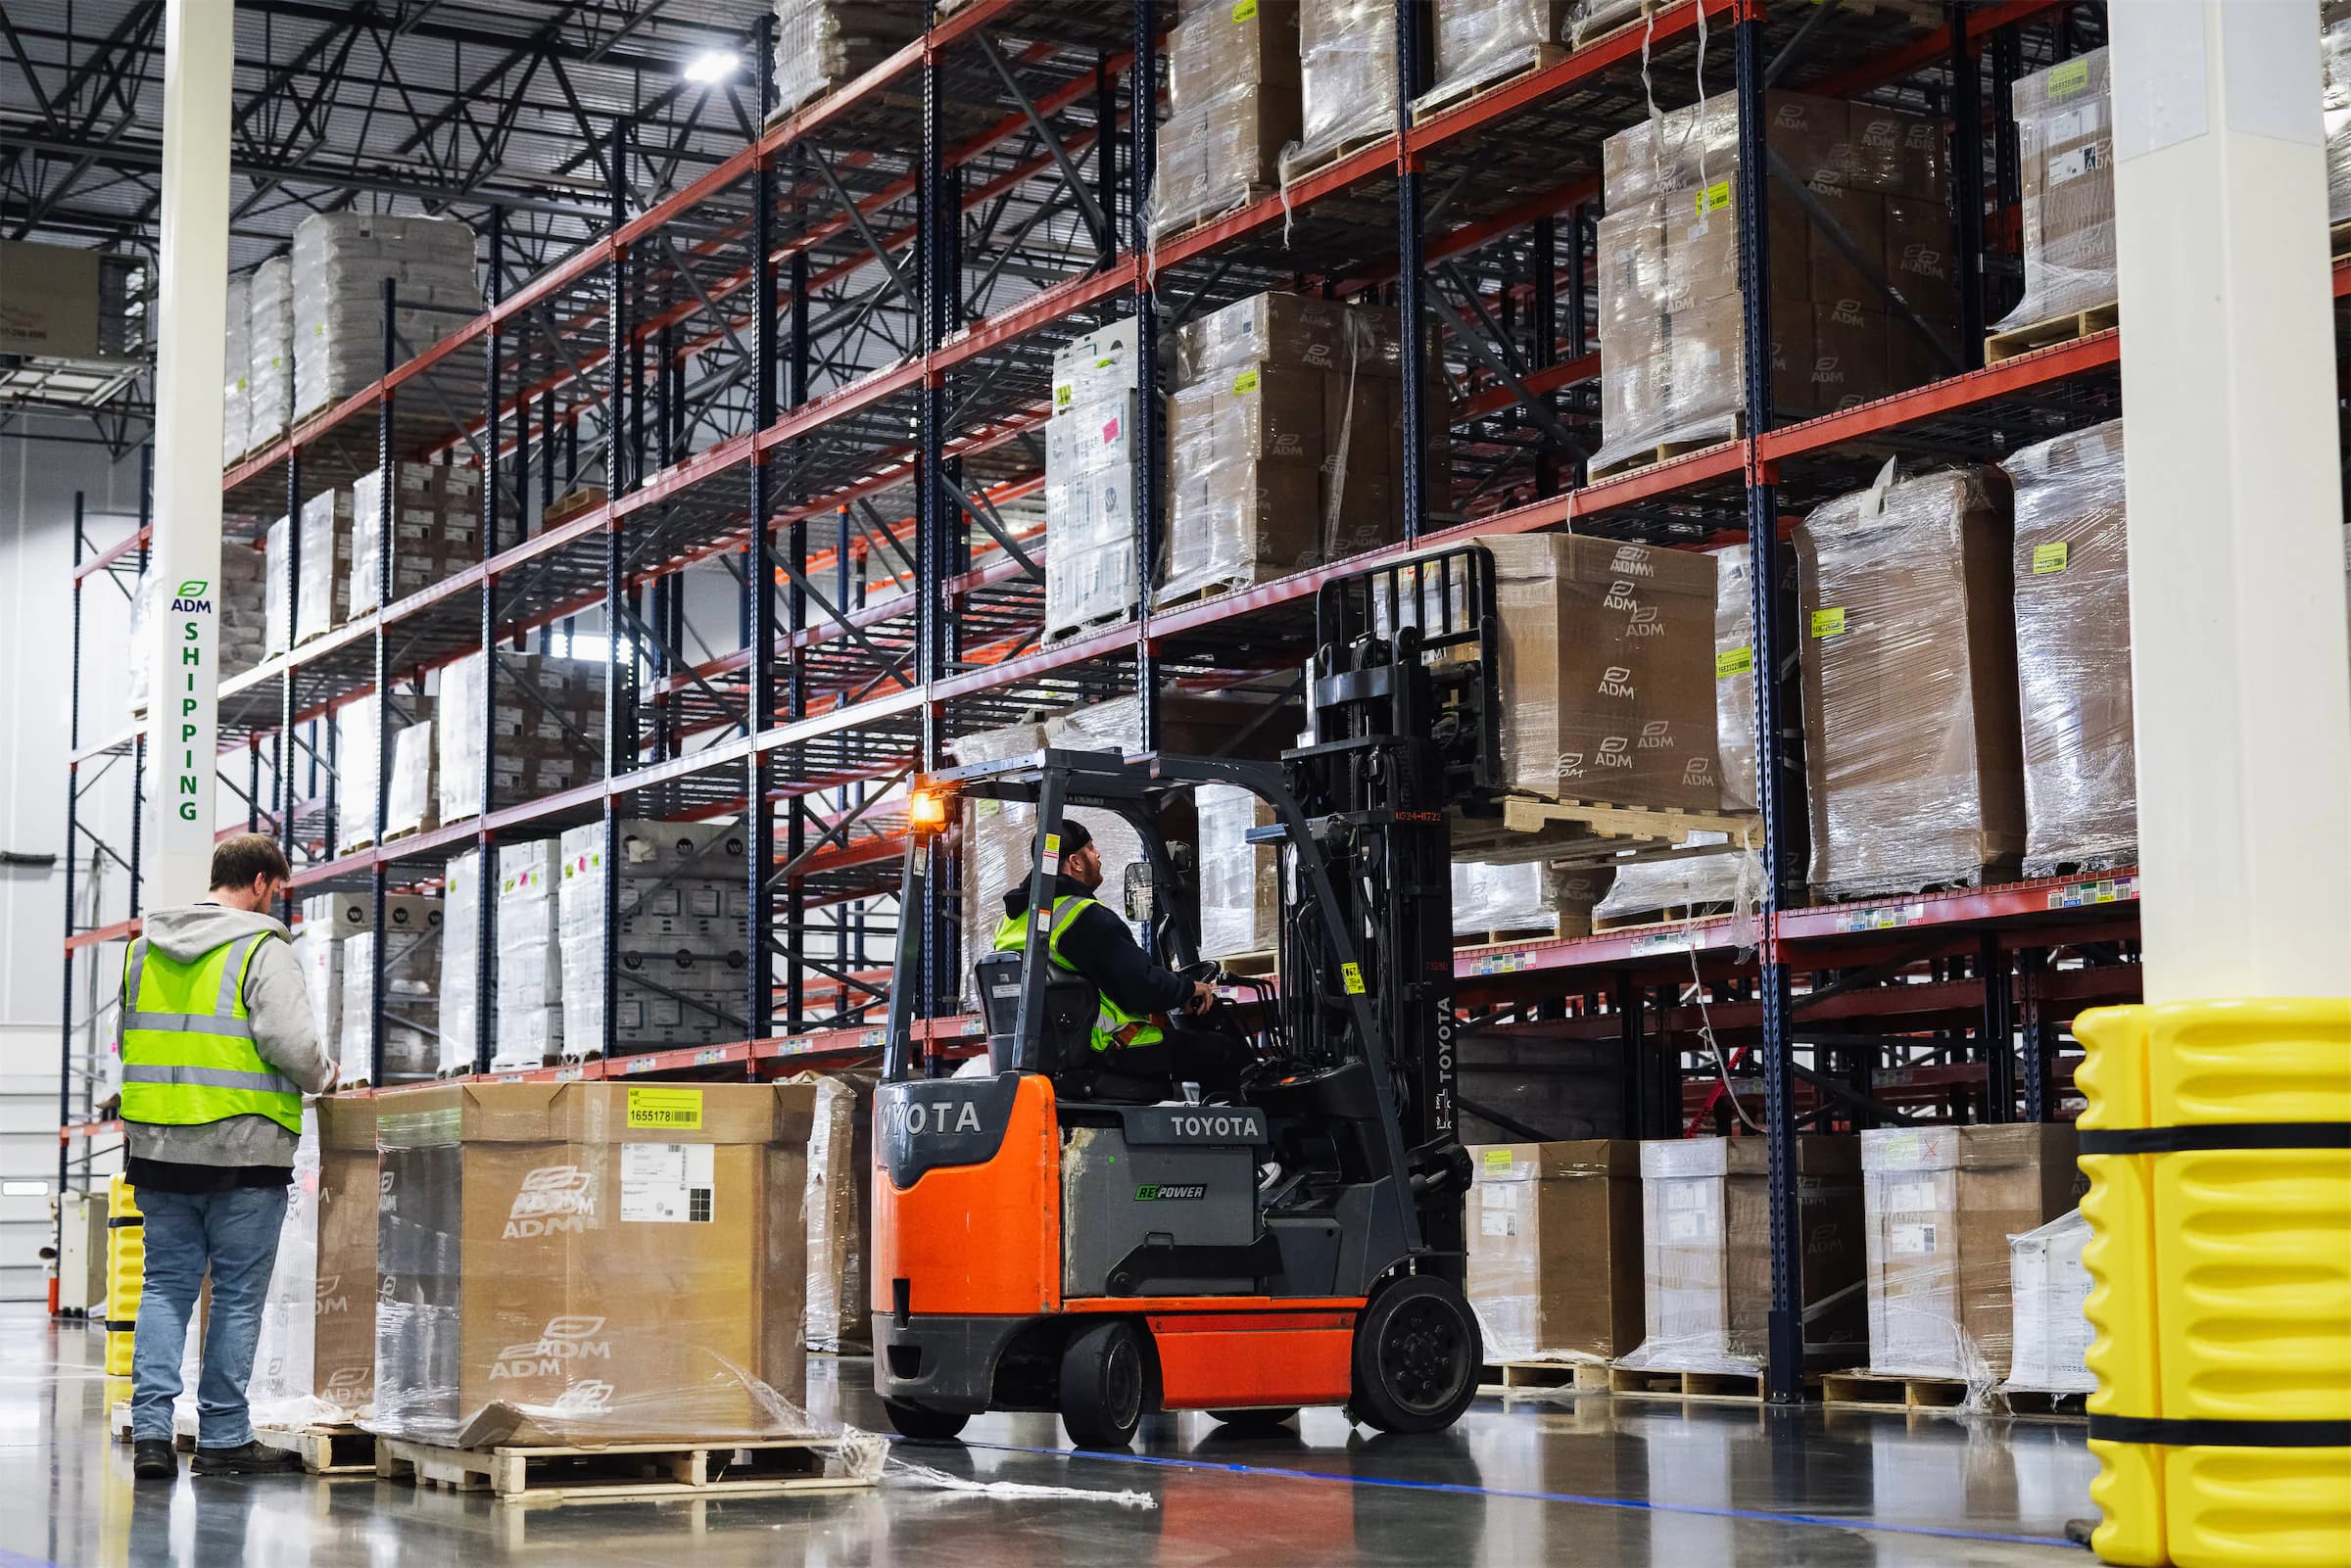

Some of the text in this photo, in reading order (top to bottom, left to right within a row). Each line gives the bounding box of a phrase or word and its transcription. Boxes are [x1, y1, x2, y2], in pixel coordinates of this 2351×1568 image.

[1774, 117, 1808, 132] ADM
[1861, 133, 1895, 149] ADM
[1807, 180, 1843, 198] ADM
[1831, 310, 1864, 328] ADM
[1302, 354, 1332, 369] ADM
[1811, 370, 1845, 383] ADM
[1272, 443, 1304, 456] ADM
[170, 598, 212, 614] ADM
[1604, 594, 1638, 612] ADM
[1626, 623, 1665, 638] ADM
[1598, 682, 1636, 701] ADM
[179, 622, 200, 822] SHIPPING
[1637, 736, 1674, 748] ADM
[1595, 753, 1633, 769] ADM
[1682, 774, 1714, 787] ADM
[1437, 997, 1453, 1083] TOYOTA
[631, 1110, 671, 1122] 1655178
[1171, 1117, 1259, 1136] TOYOTA
[502, 1217, 584, 1240] ADM
[536, 1338, 611, 1359] ADM
[489, 1358, 561, 1380] ADM
[321, 1387, 374, 1403] ADM
